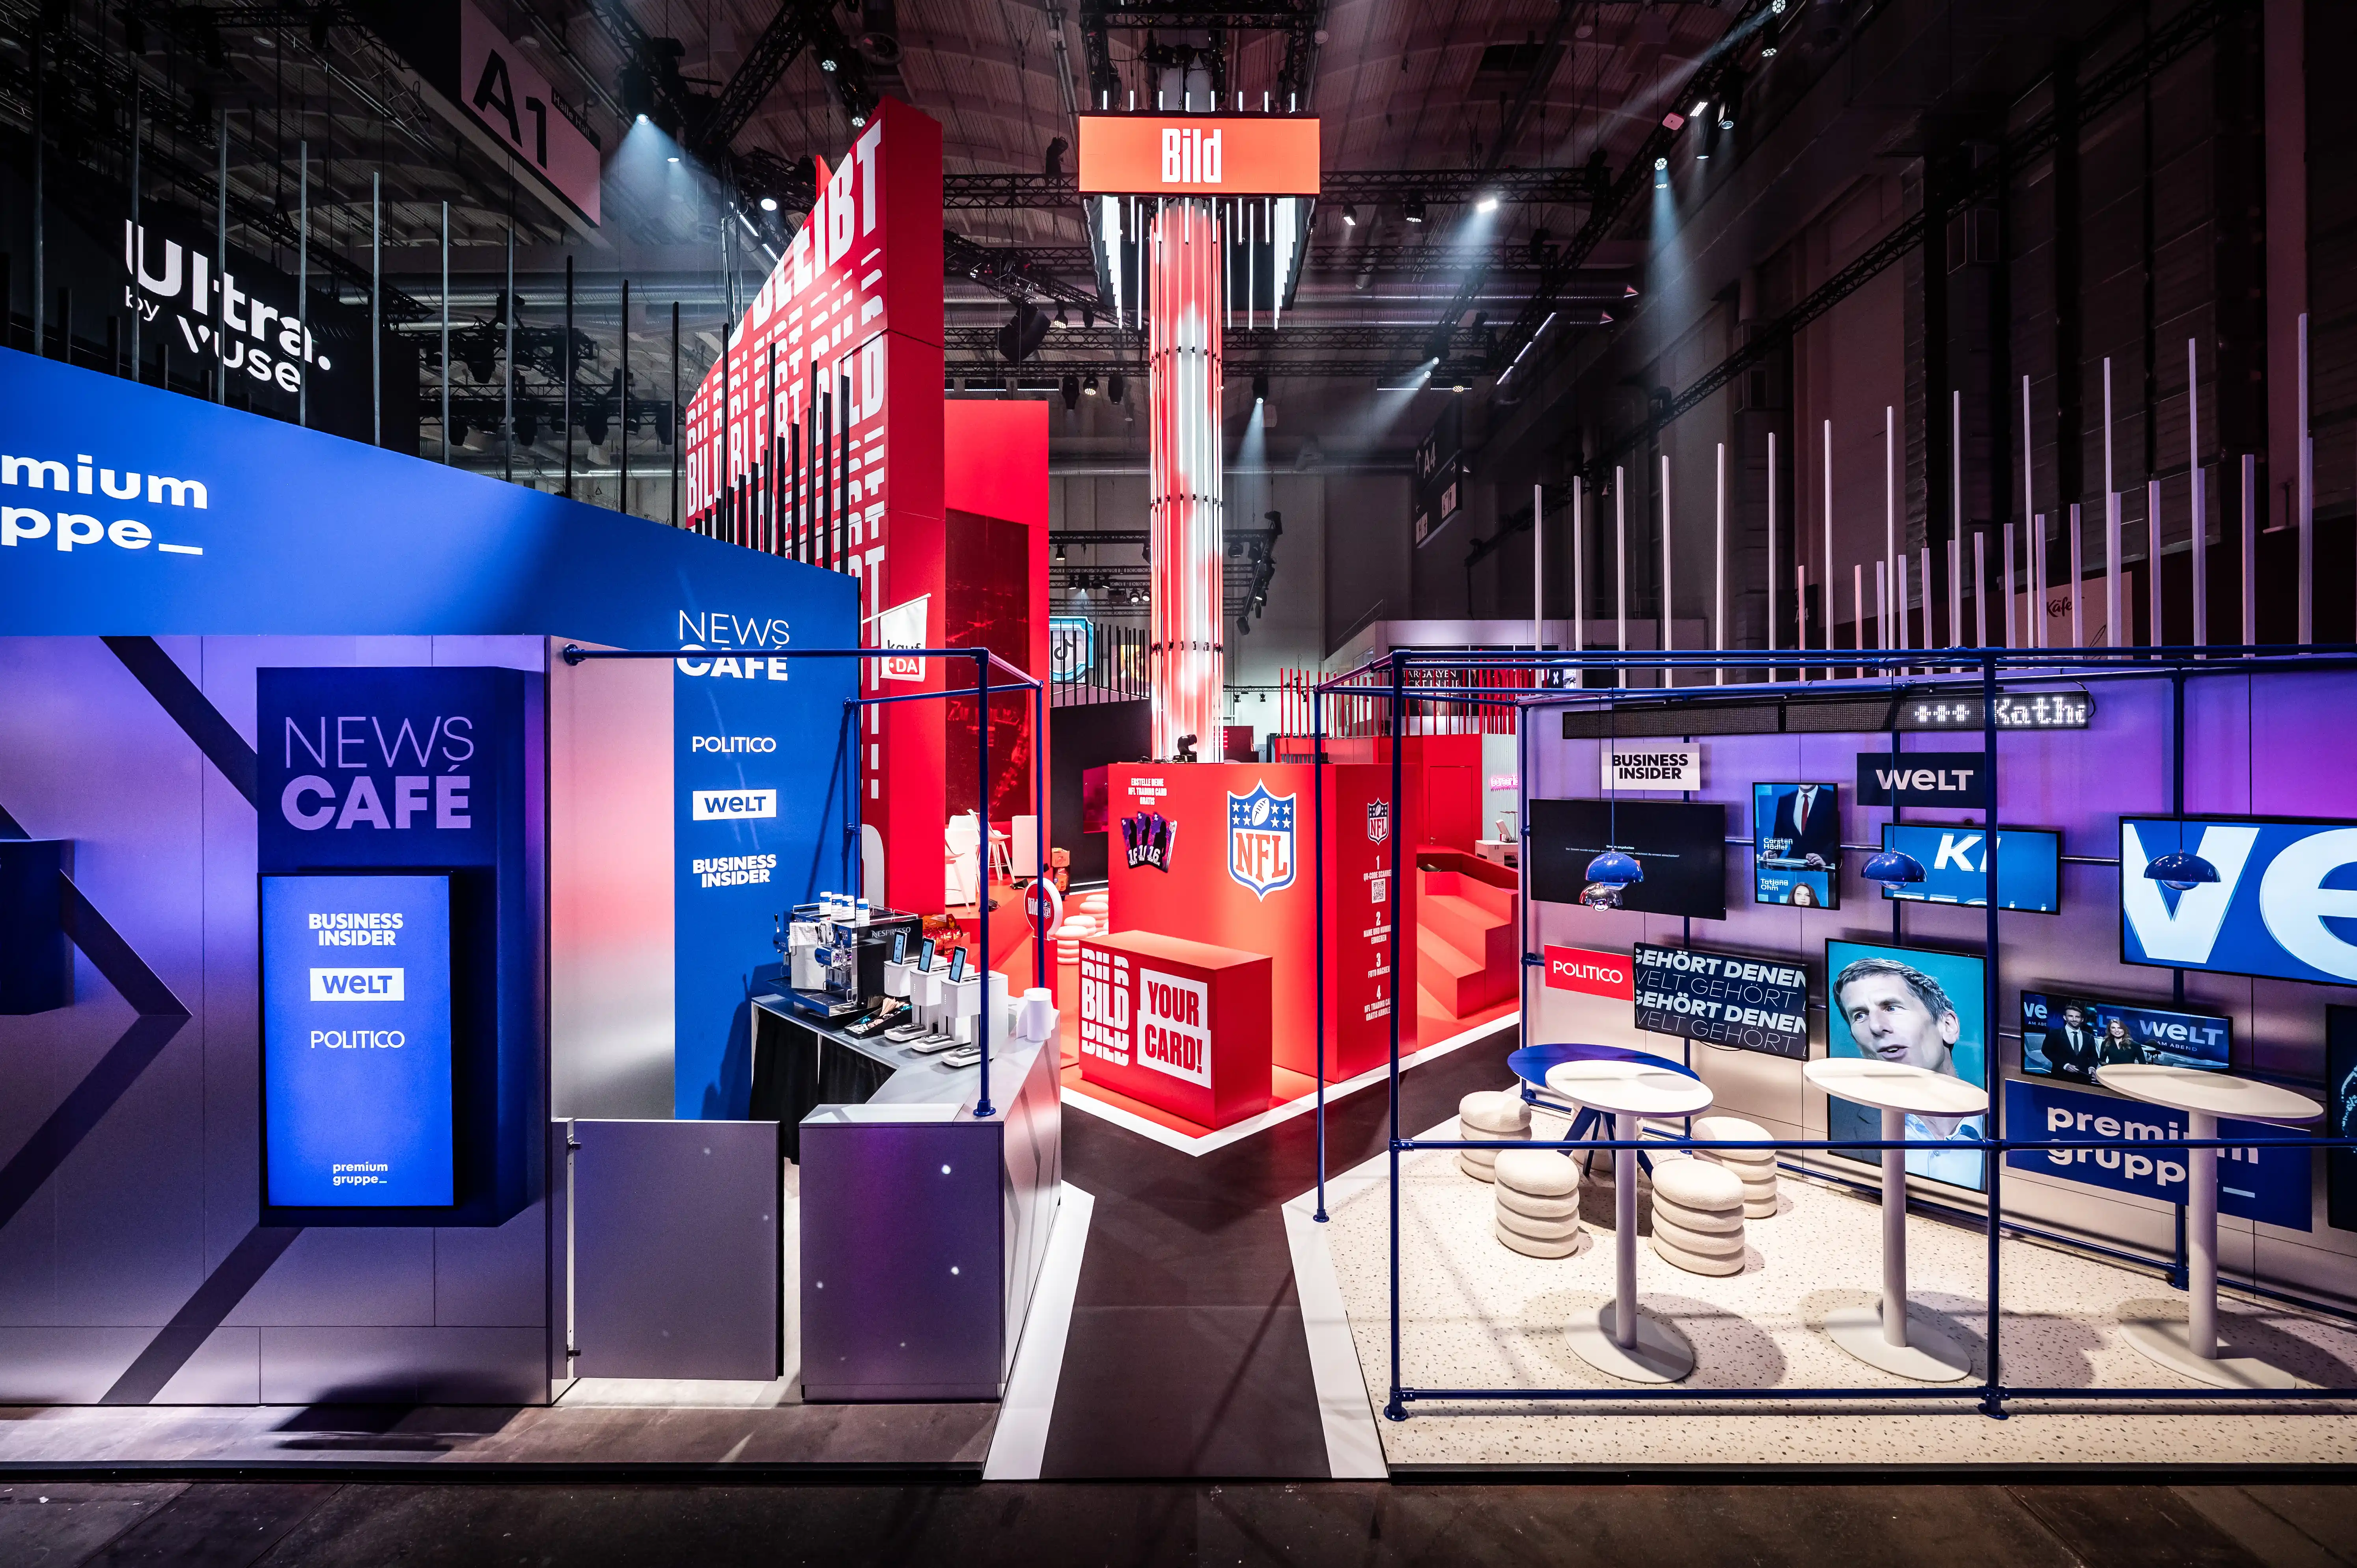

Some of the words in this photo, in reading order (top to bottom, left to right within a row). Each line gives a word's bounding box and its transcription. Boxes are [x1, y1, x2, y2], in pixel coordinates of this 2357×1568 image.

[472, 48, 547, 170] A1
[553, 93, 573, 119] Halle
[576, 115, 590, 137] Hall
[1161, 128, 1222, 183] Bild
[1, 454, 208, 509] mium
[679, 610, 789, 647] NEWS
[676, 644, 788, 681] CAFÉ
[285, 716, 474, 768] NEWS
[692, 736, 776, 753] POLITICO
[1613, 754, 1689, 766] BUSINESS
[1619, 767, 1682, 779] INSIDER
[281, 764, 471, 831] CAFÉ
[1370, 818, 1387, 838] NFL
[693, 854, 777, 874] BUSINESS
[1235, 832, 1288, 884] NFL
[1376, 855, 1380, 870] 1
[702, 869, 771, 888] INSIDER
[309, 912, 403, 930] BUSINESS
[1376, 911, 1381, 926] 2
[318, 929, 396, 946] INSIDER
[1380, 925, 1391, 934] NUMM
[1376, 953, 1381, 967] 3
[1553, 960, 1623, 983] POLITICO
[1376, 985, 1381, 999] 4
[1691, 978, 1797, 1008] GEHÖRT
[1082, 977, 1129, 1031] BILD
[1147, 980, 1199, 1027] YOUR
[311, 1030, 405, 1049] POLITICO
[1692, 1020, 1797, 1052] GEHÖRT
[1145, 1024, 1203, 1074] CARD!
[2170, 1043, 2197, 1052] ABEND
[2047, 1107, 2258, 1165] premim
[333, 1161, 388, 1175] premium
